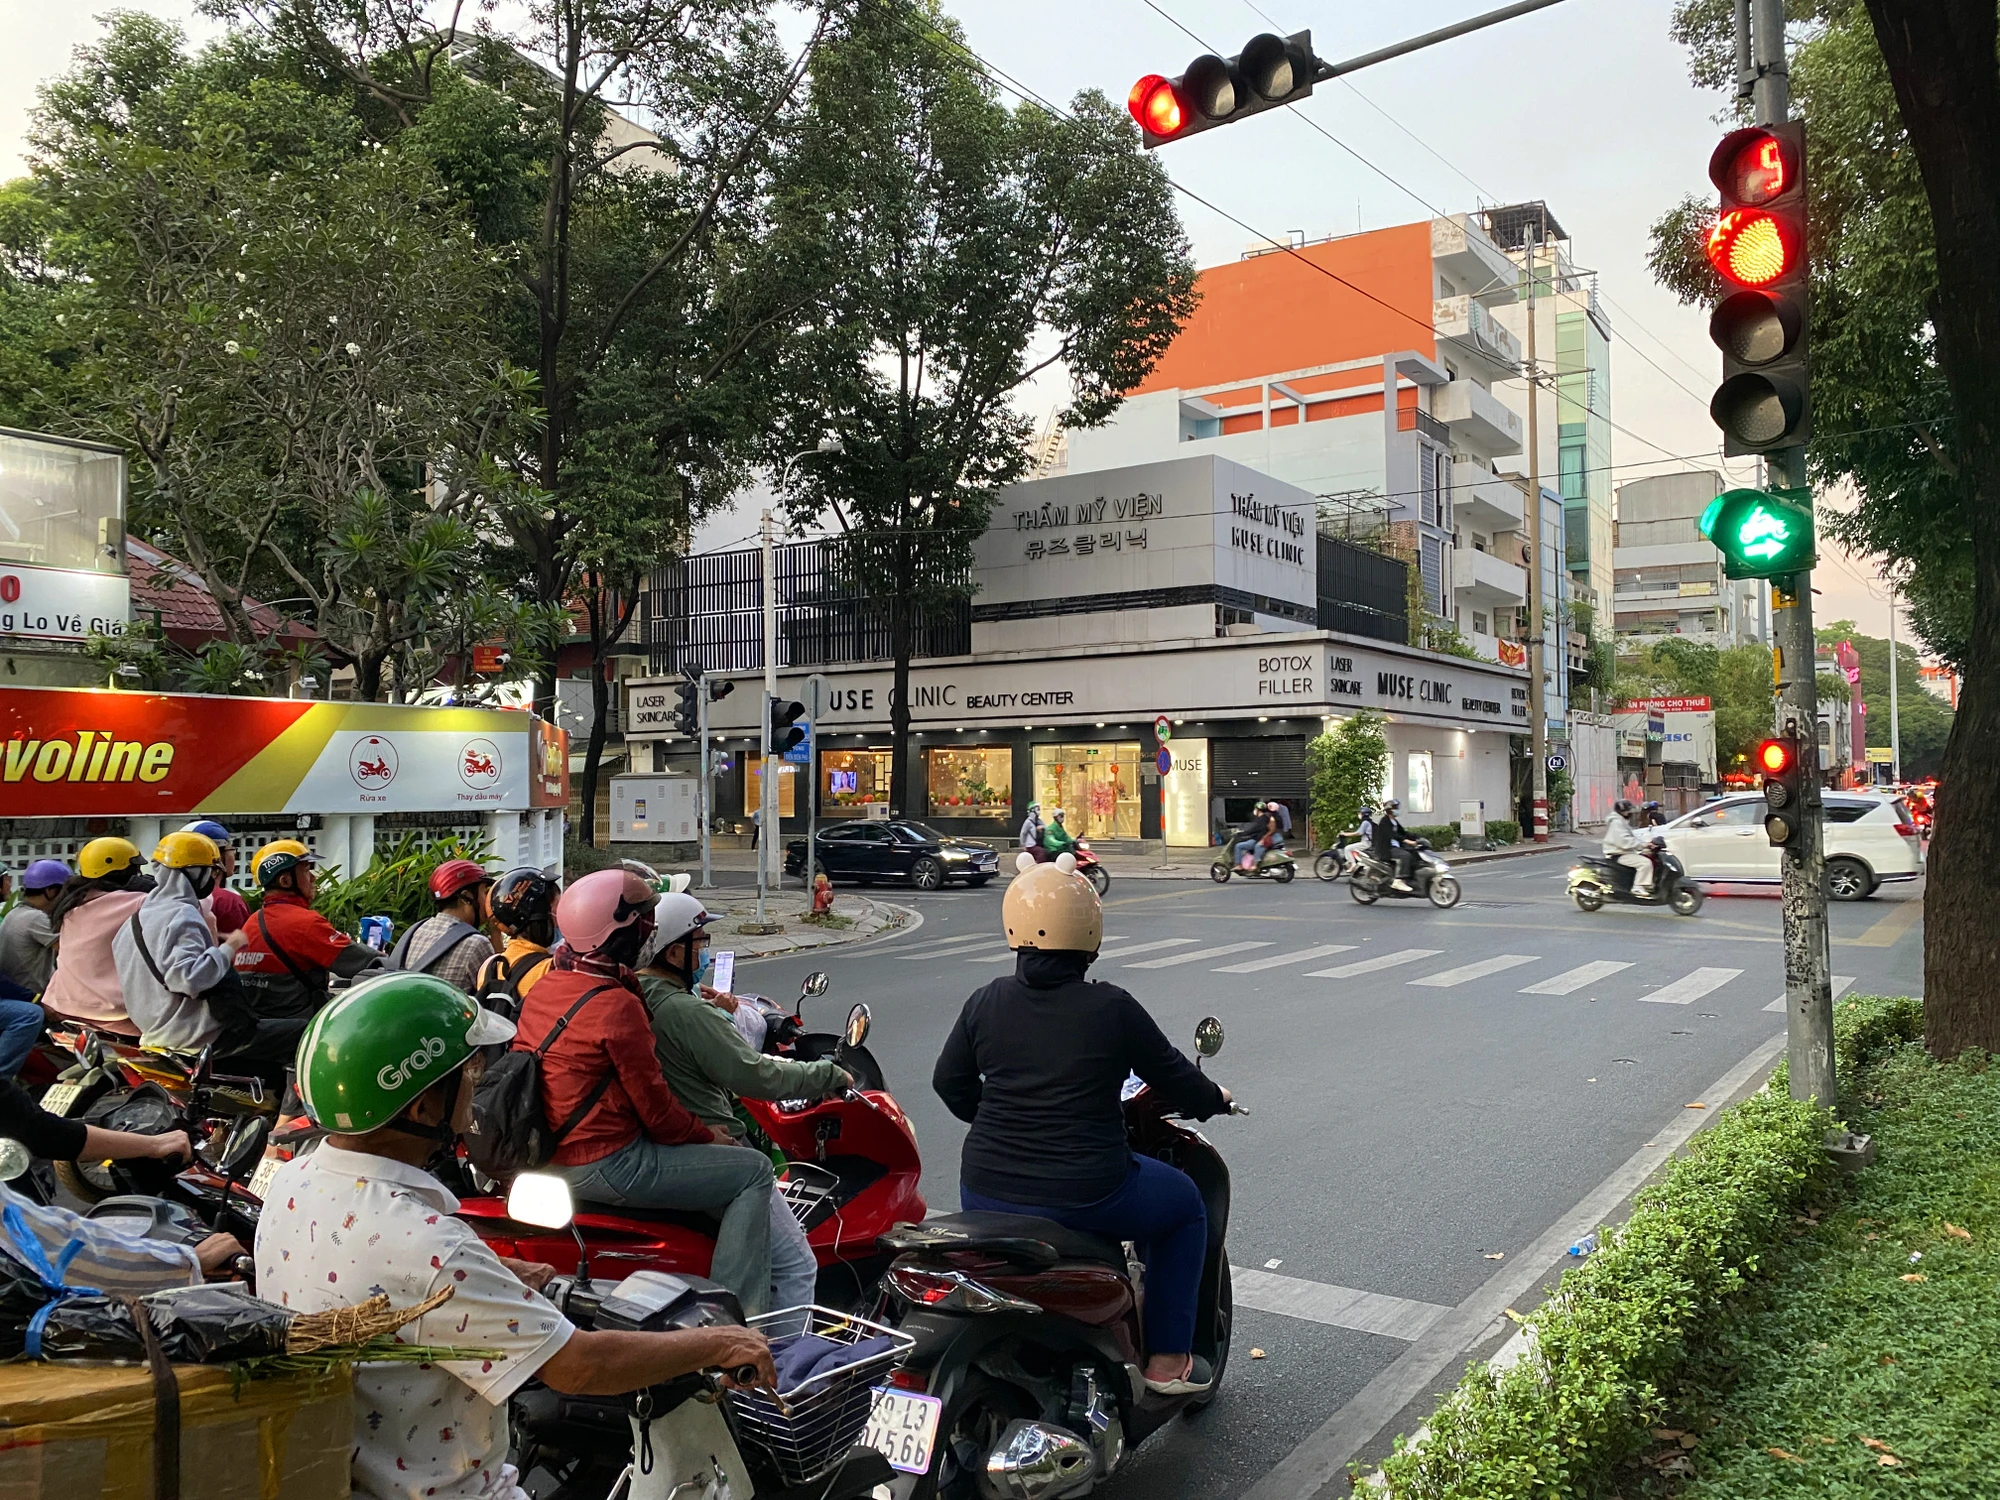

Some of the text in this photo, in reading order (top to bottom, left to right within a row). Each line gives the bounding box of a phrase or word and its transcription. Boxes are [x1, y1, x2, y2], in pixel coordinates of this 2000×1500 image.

[1076, 496, 1107, 524] MỸ
[1114, 492, 1162, 521] VIỆN
[1282, 511, 1305, 538] VIỆN
[1025, 527, 1147, 560] 뮤즈클리닉
[1231, 526, 1304, 566] MUSE CLINIC
[23, 612, 48, 630] Lo
[56, 613, 82, 633] Về
[90, 617, 122, 636] Giá
[1259, 655, 1313, 673] BOTOX
[1330, 656, 1353, 672] LASER
[1259, 678, 1313, 695] FILLER
[1330, 678, 1363, 695] SKINCARE
[1377, 671, 1452, 704] MUSE CLINIC
[636, 695, 665, 708] LASER
[829, 689, 874, 711] USE
[966, 691, 1074, 709] BEAUTY CENTER
[1627, 697, 1706, 709] ĂN PHÒNG CHO THUÊ
[636, 710, 680, 724] SKINCARE
[0, 731, 175, 783] voline
[1170, 759, 1203, 771] MUSE
[456, 794, 473, 803] Thay
[488, 793, 503, 802] máy
[376, 1036, 446, 1091] Grab
